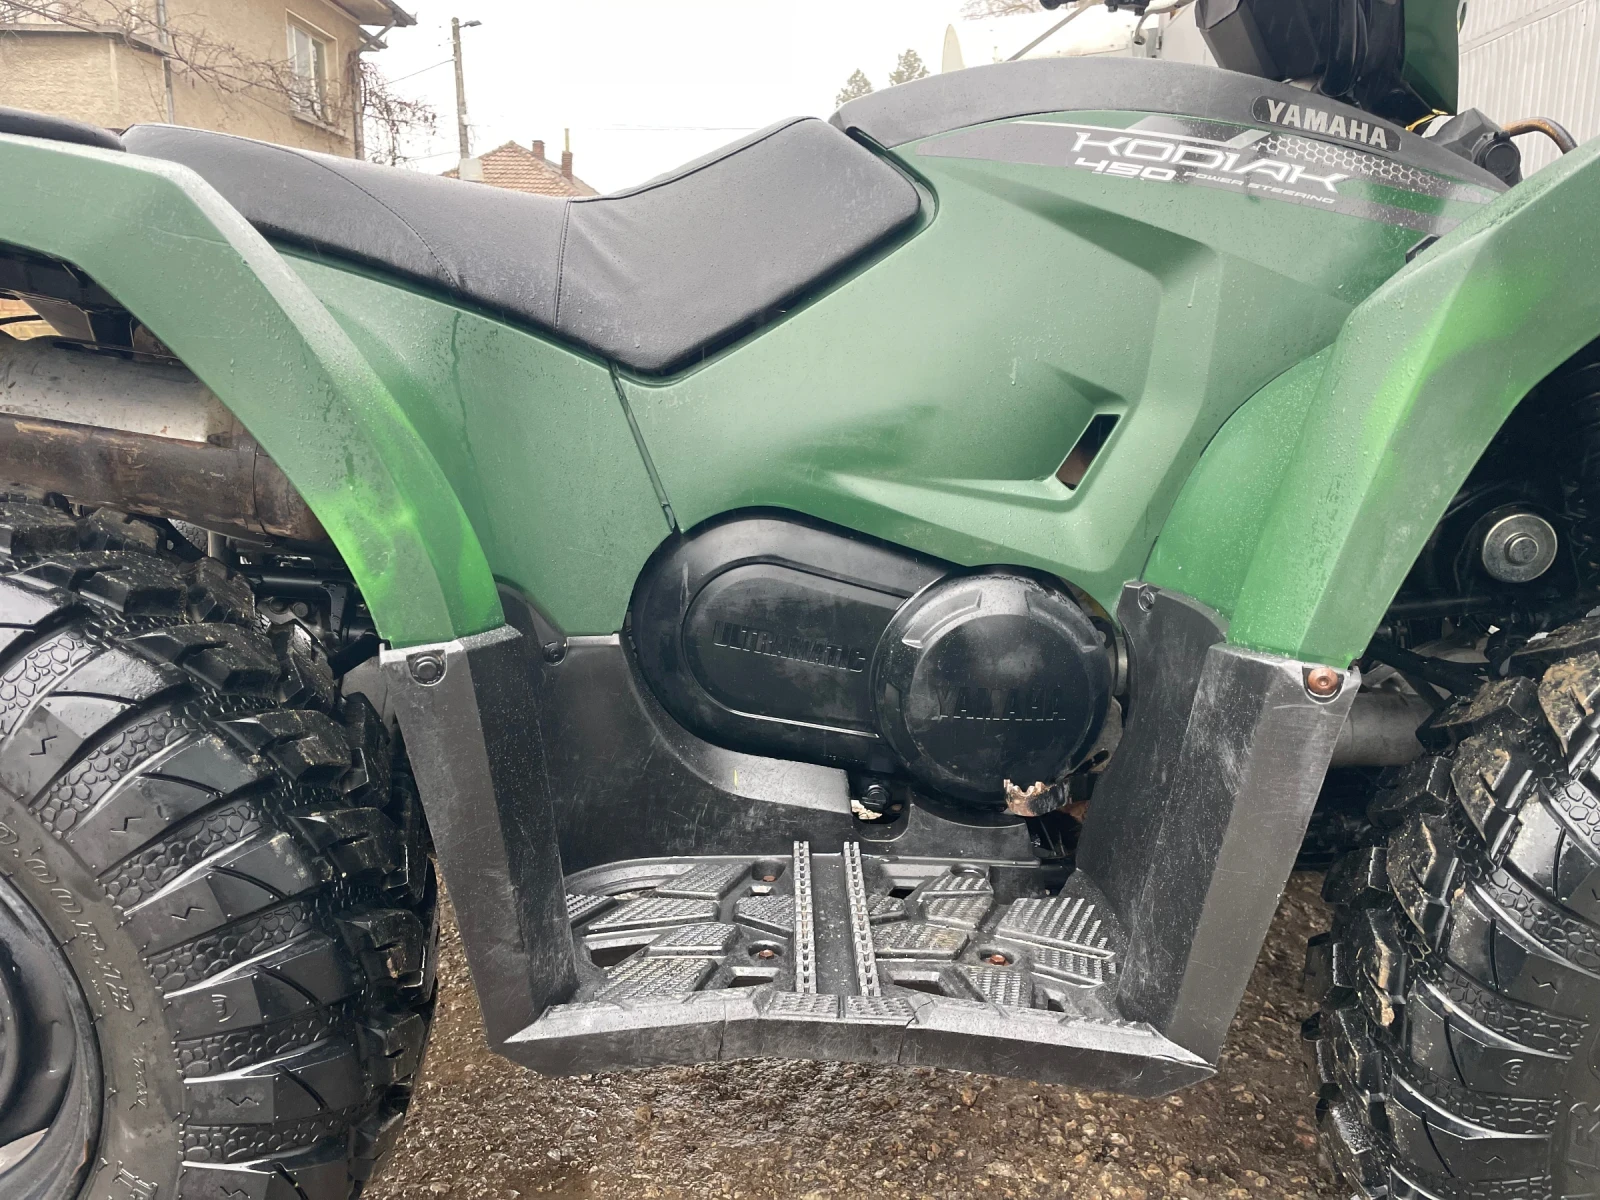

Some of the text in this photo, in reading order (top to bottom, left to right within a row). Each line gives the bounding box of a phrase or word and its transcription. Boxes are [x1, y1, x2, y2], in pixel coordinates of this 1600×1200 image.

[1267, 99, 1388, 149] YAMAHA
[1070, 132, 1347, 193] KODIAK
[1075, 157, 1335, 204] 450 POWER STEERING
[711, 620, 867, 673] ULTRAMATIC
[931, 686, 1066, 722] YAMAHA
